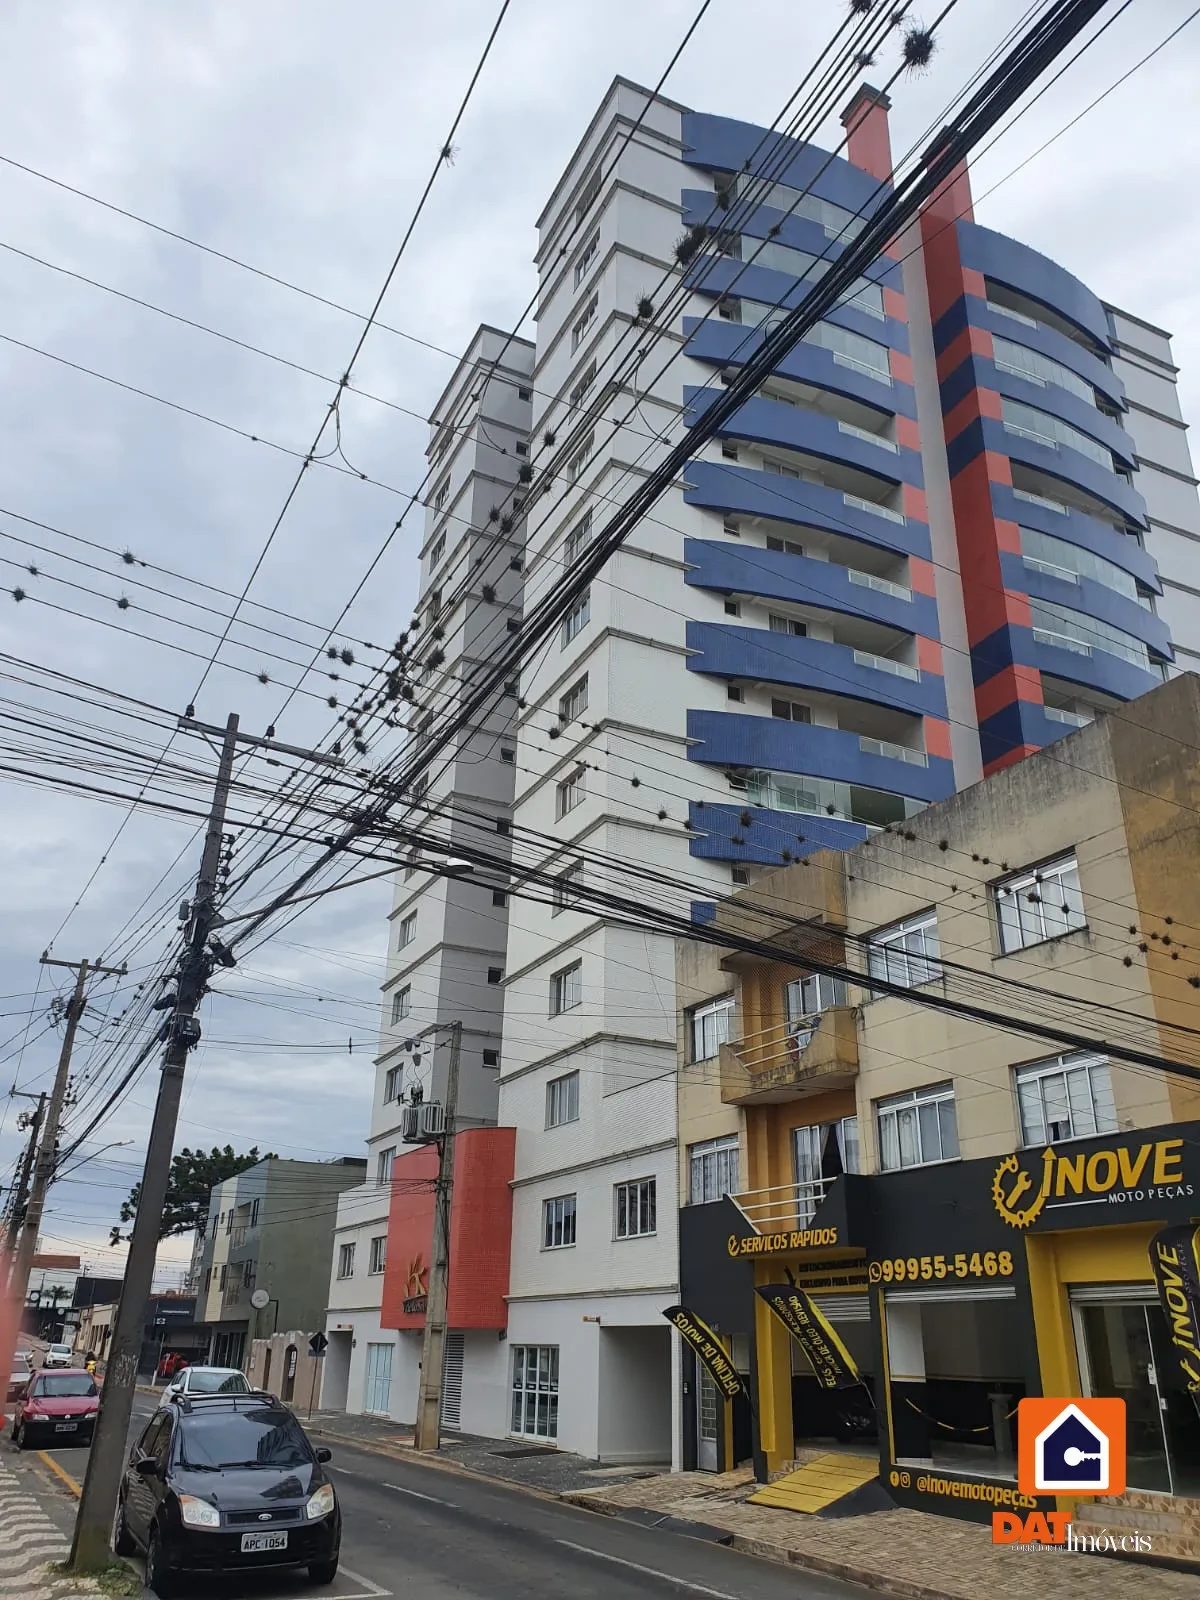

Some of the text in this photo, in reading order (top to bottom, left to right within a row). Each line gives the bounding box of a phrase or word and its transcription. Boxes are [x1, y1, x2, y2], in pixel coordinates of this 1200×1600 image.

[1041, 1139, 1184, 1197] INOVE
[1109, 1184, 1194, 1204] MOTO PEÇAS
[741, 1233, 788, 1253] SERVIÇOS
[882, 1250, 1014, 1282] 99955-5468
[701, 1342, 717, 1358] DE
[711, 1354, 740, 1395] OFICINA
